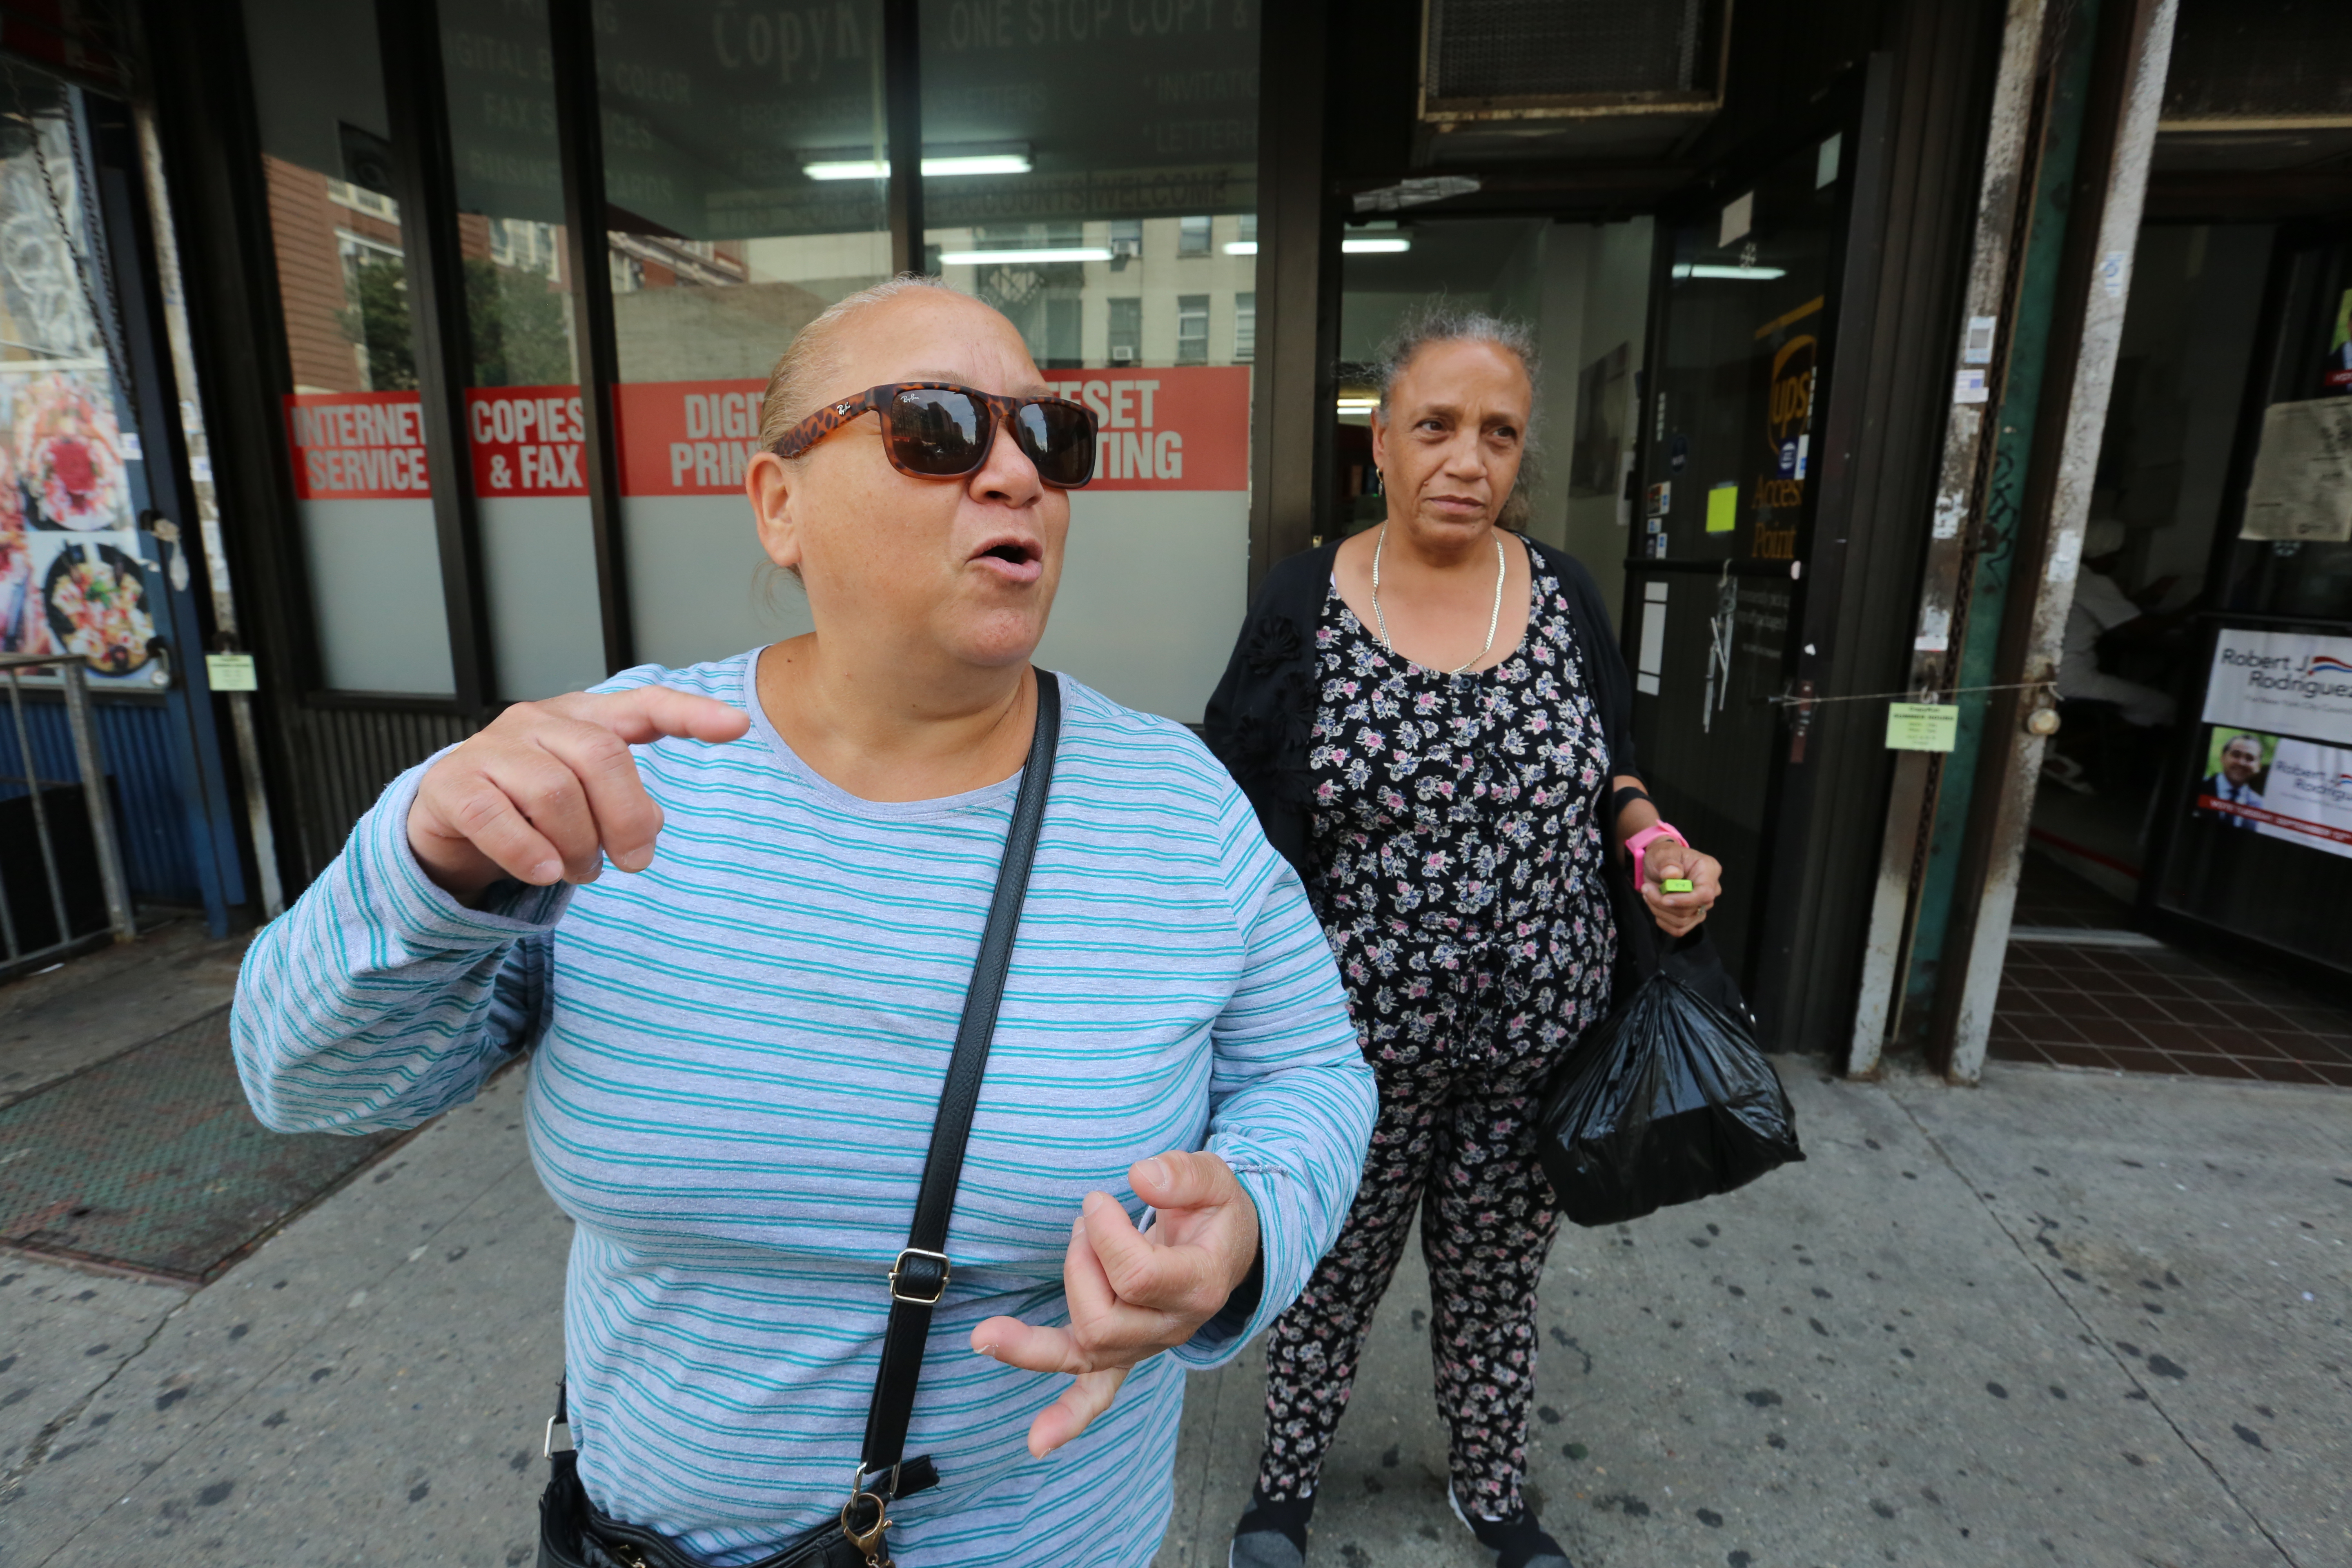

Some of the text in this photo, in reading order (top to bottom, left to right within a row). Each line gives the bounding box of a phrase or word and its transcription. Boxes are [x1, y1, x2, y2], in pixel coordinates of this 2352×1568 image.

[470, 396, 586, 444] COPIES
[306, 448, 429, 491] SERVICE
[490, 445, 584, 488] & FAX
[2221, 648, 2290, 670] Robert
